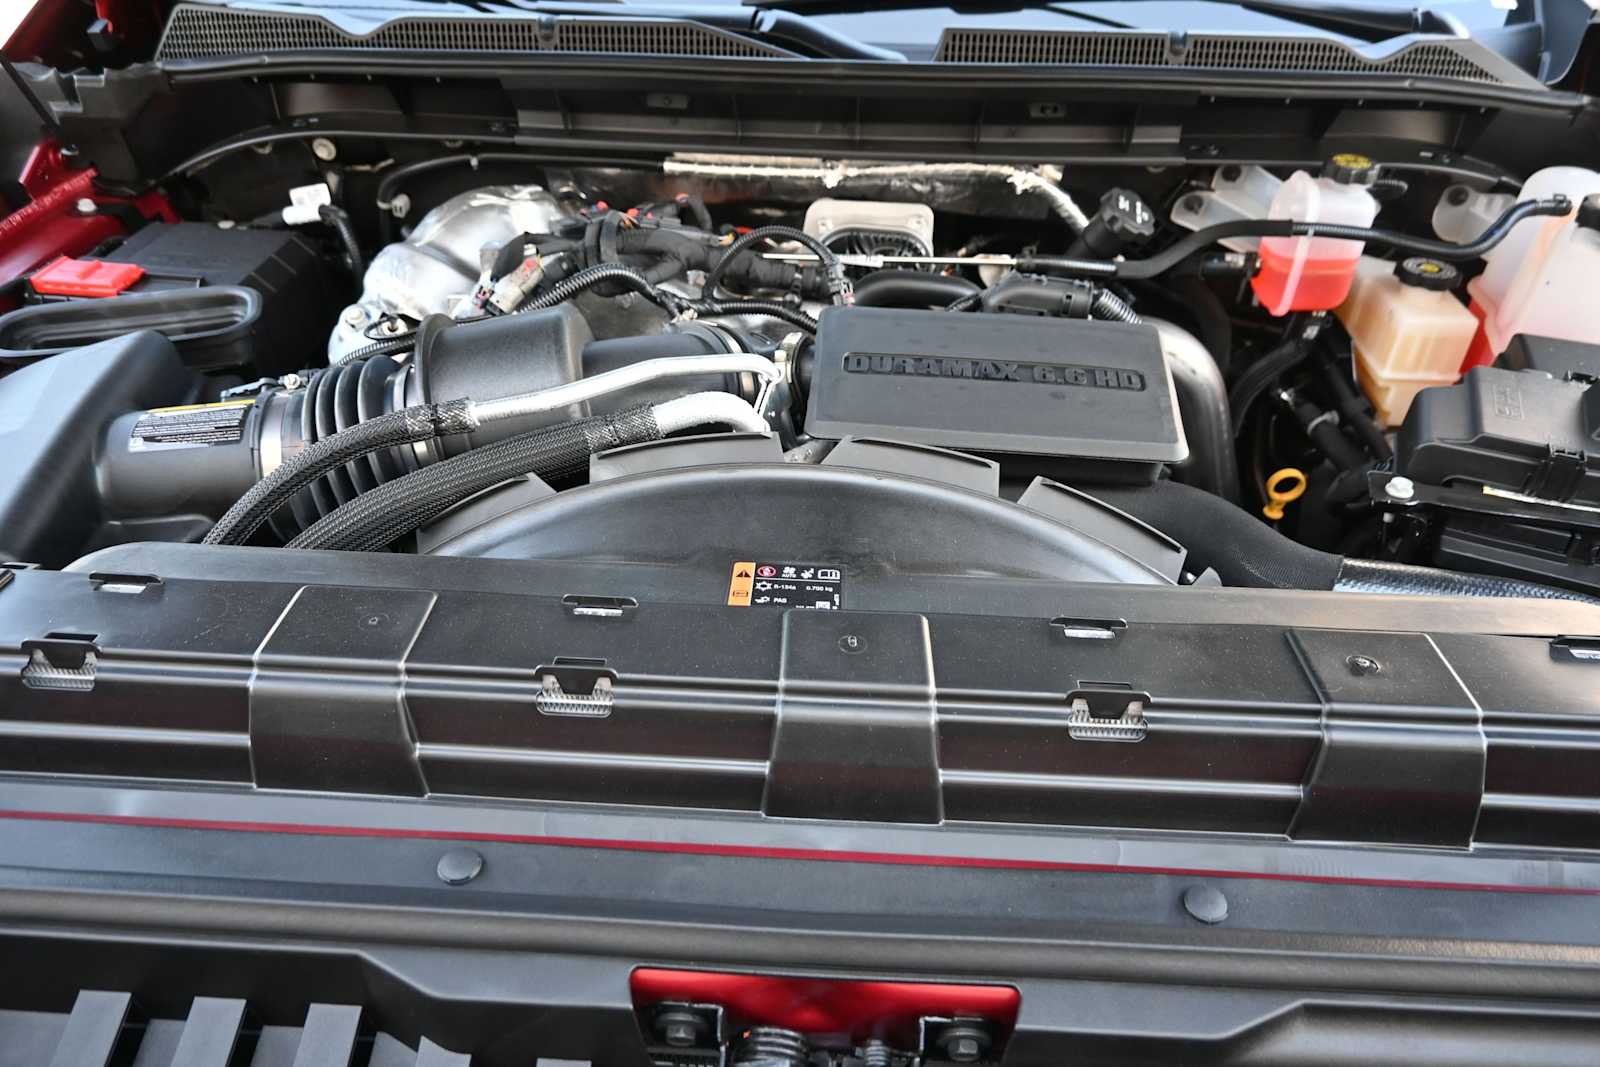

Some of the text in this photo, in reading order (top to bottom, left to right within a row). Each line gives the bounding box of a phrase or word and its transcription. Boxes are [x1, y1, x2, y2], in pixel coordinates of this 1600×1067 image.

[847, 356, 1142, 390] DURAMAX 6.6 HD
